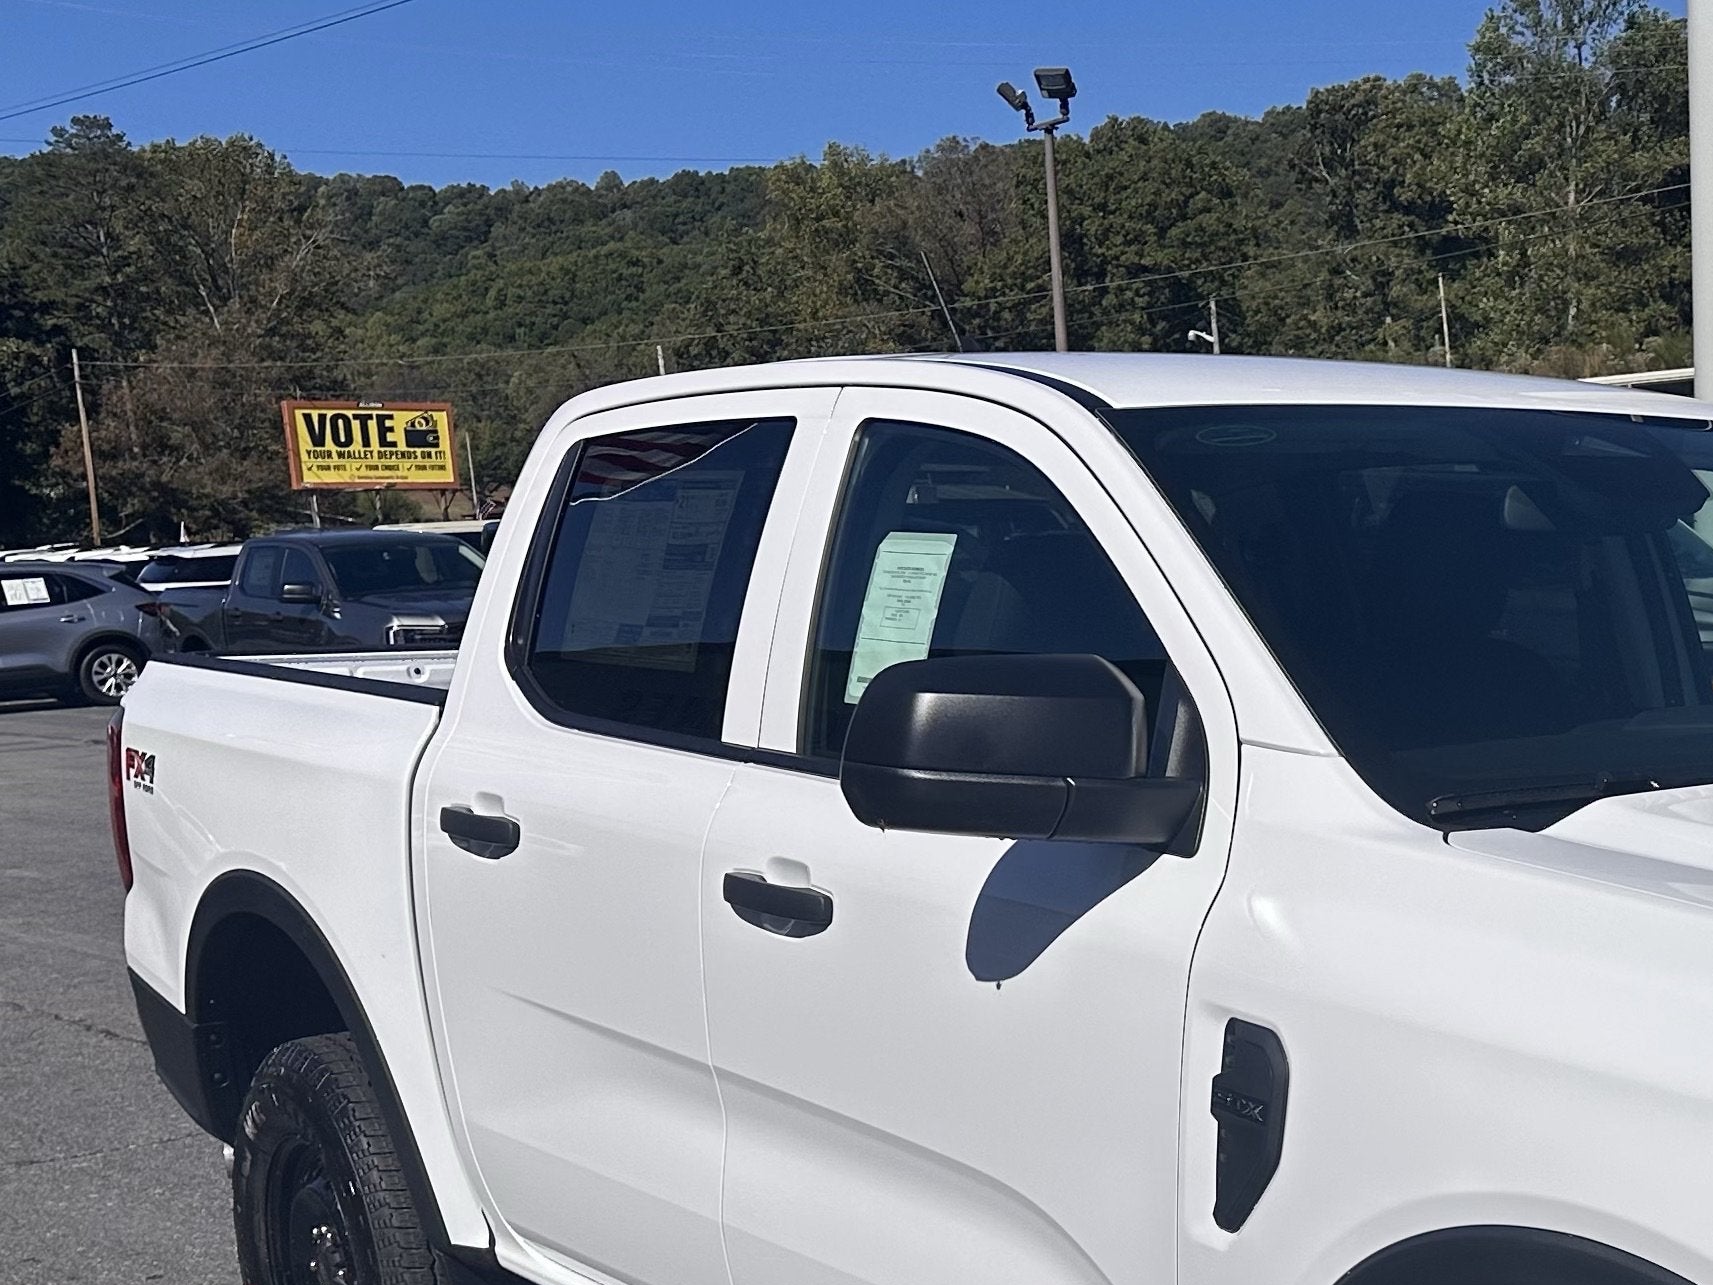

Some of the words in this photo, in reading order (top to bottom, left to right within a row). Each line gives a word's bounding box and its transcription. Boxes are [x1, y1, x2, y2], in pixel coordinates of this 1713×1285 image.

[302, 413, 398, 448] VOTE
[305, 449, 333, 460] YOUR
[336, 449, 374, 460] WALLET
[377, 450, 418, 460] DEPENDS
[421, 450, 433, 460] ON
[316, 464, 331, 472] YOUR
[333, 464, 347, 472] VOTE
[365, 464, 379, 472] YOUR
[414, 464, 427, 472] YOUR
[126, 747, 156, 784] FX4
